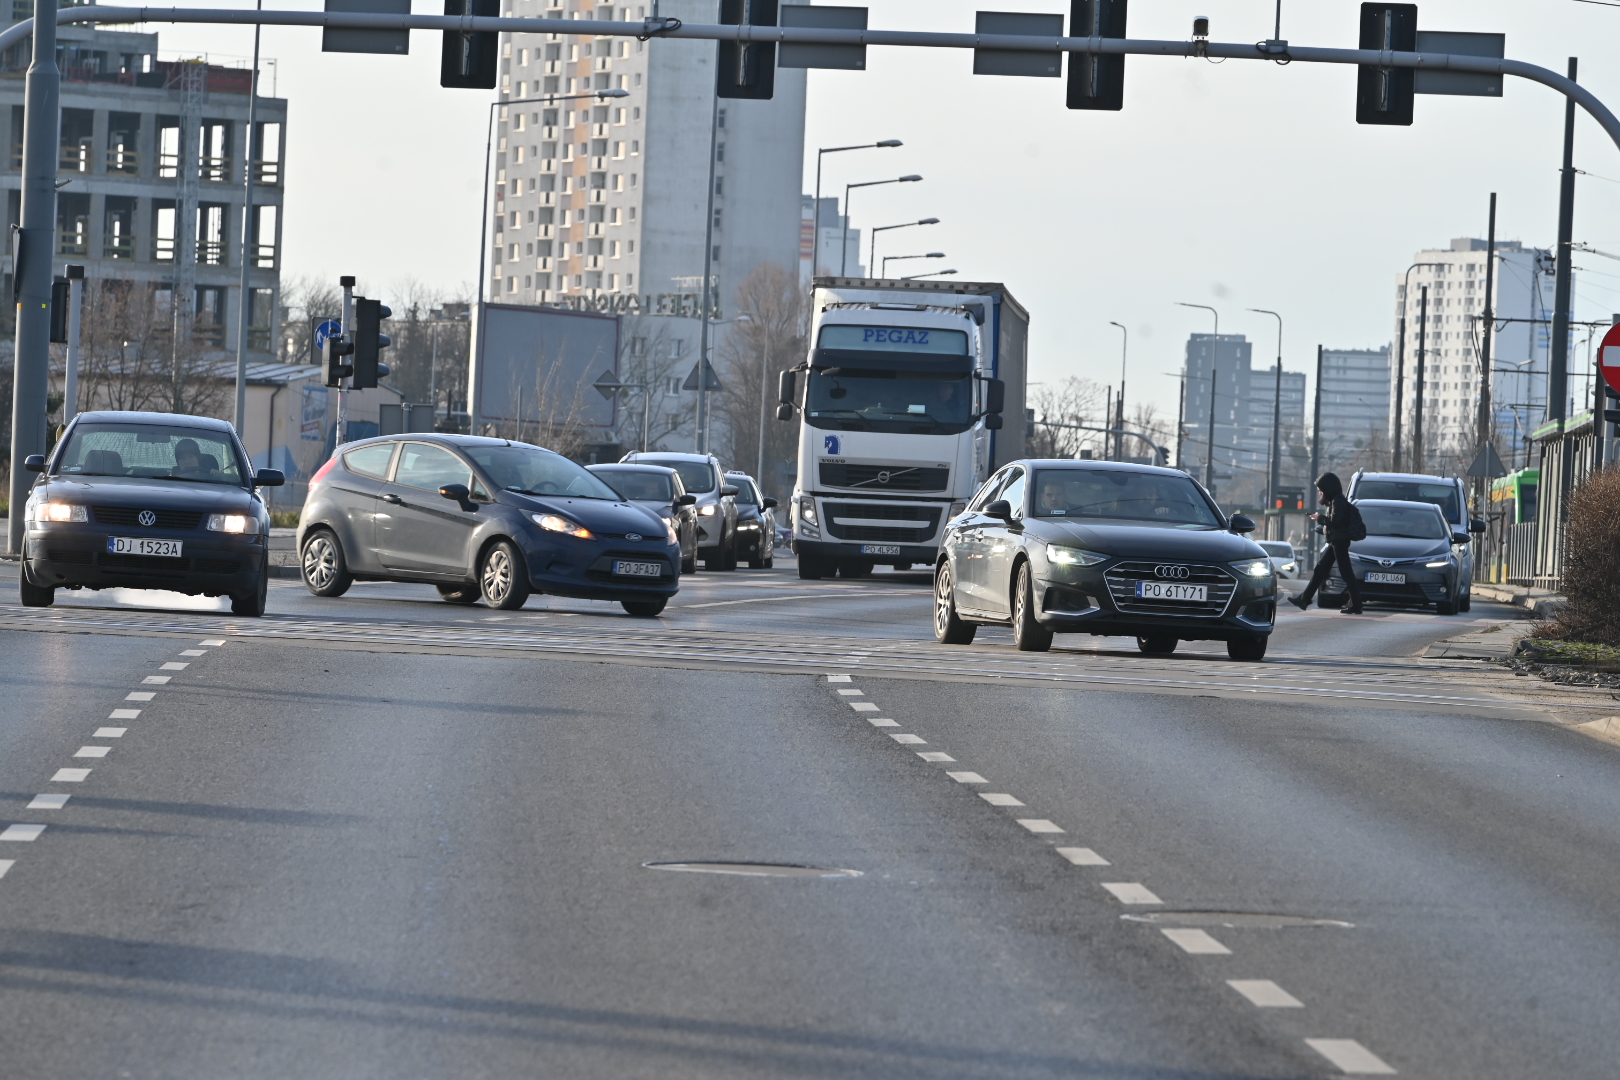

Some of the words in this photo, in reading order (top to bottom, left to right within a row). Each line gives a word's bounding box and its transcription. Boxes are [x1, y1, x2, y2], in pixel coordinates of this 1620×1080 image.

[862, 328, 929, 345] PEGAZ
[116, 539, 133, 552] DJ
[140, 541, 178, 556] 1523A
[864, 545, 876, 554] PO
[619, 562, 632, 574] PO
[633, 563, 660, 575] 3FA37
[1144, 584, 1161, 597] PO
[1165, 585, 1203, 600] 6TY71
